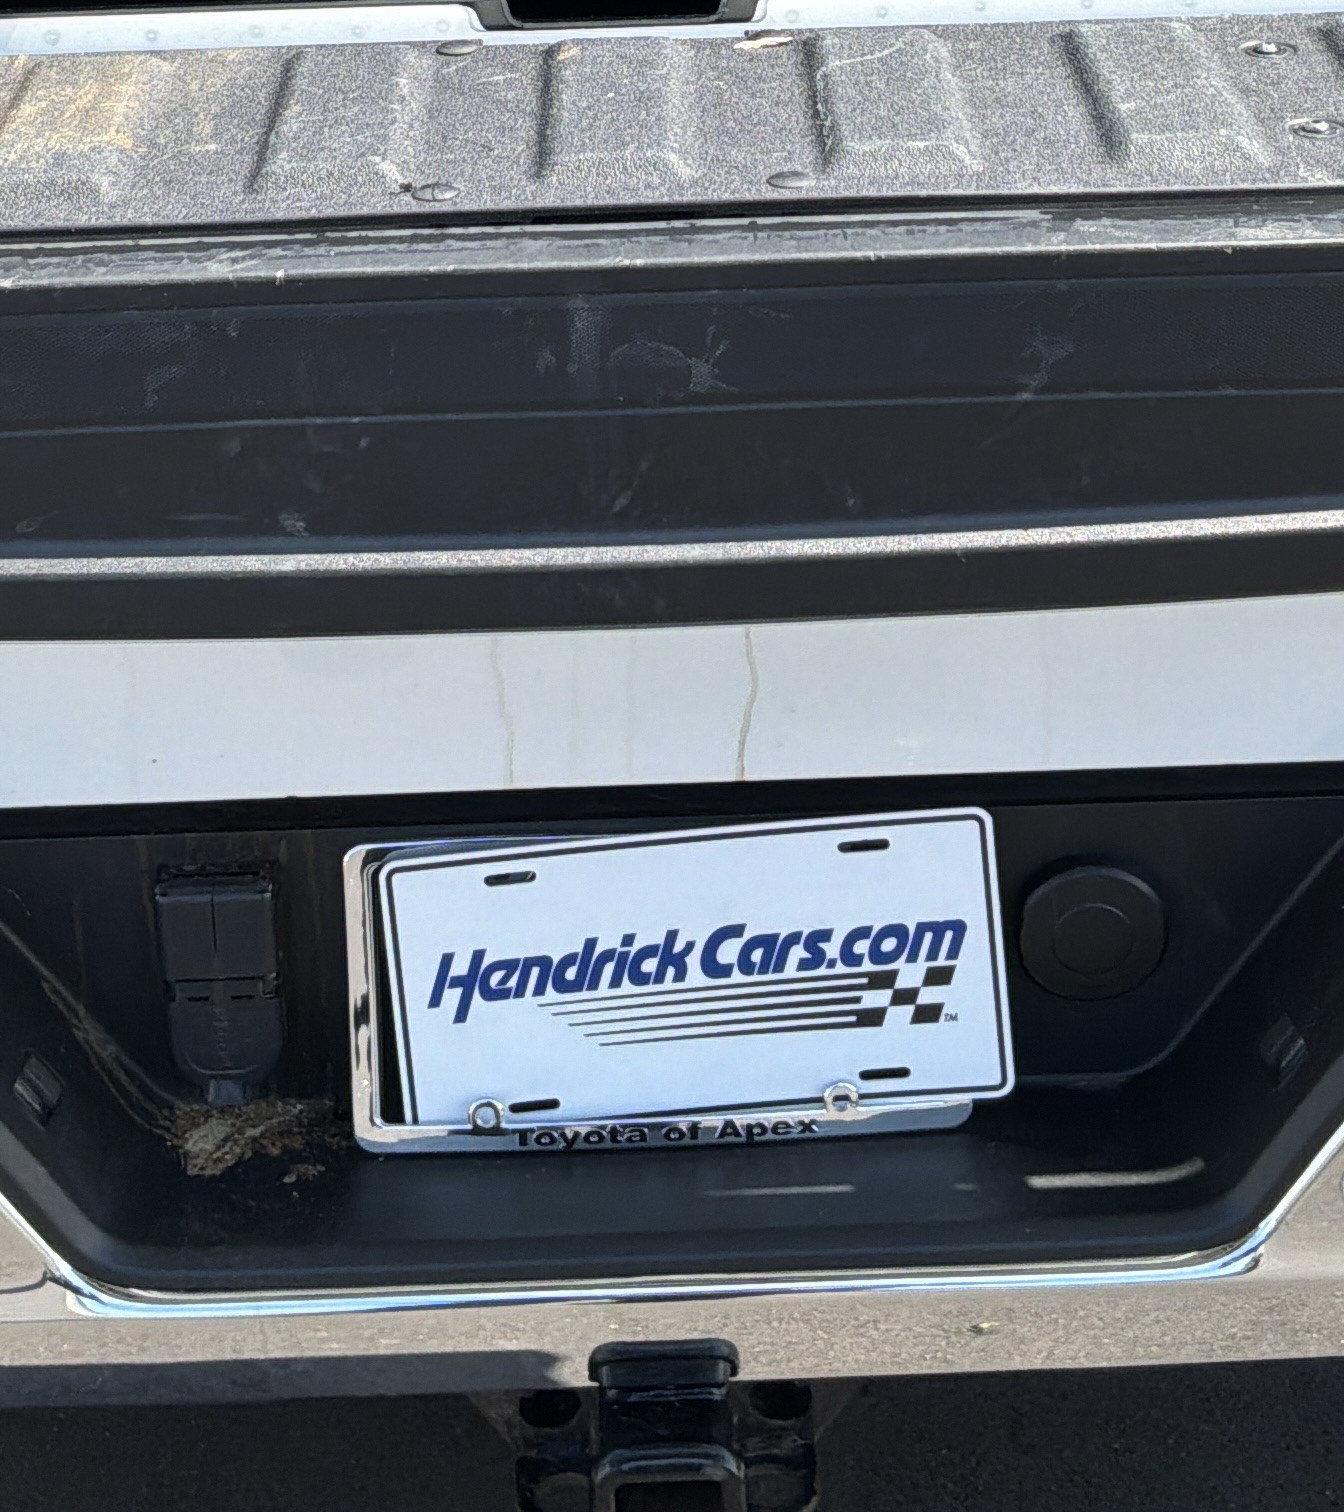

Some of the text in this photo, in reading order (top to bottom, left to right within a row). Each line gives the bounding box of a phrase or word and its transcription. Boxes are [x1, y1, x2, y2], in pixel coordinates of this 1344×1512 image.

[427, 929, 695, 1024] Hendrick
[515, 1117, 819, 1149] Toyota of Apex
